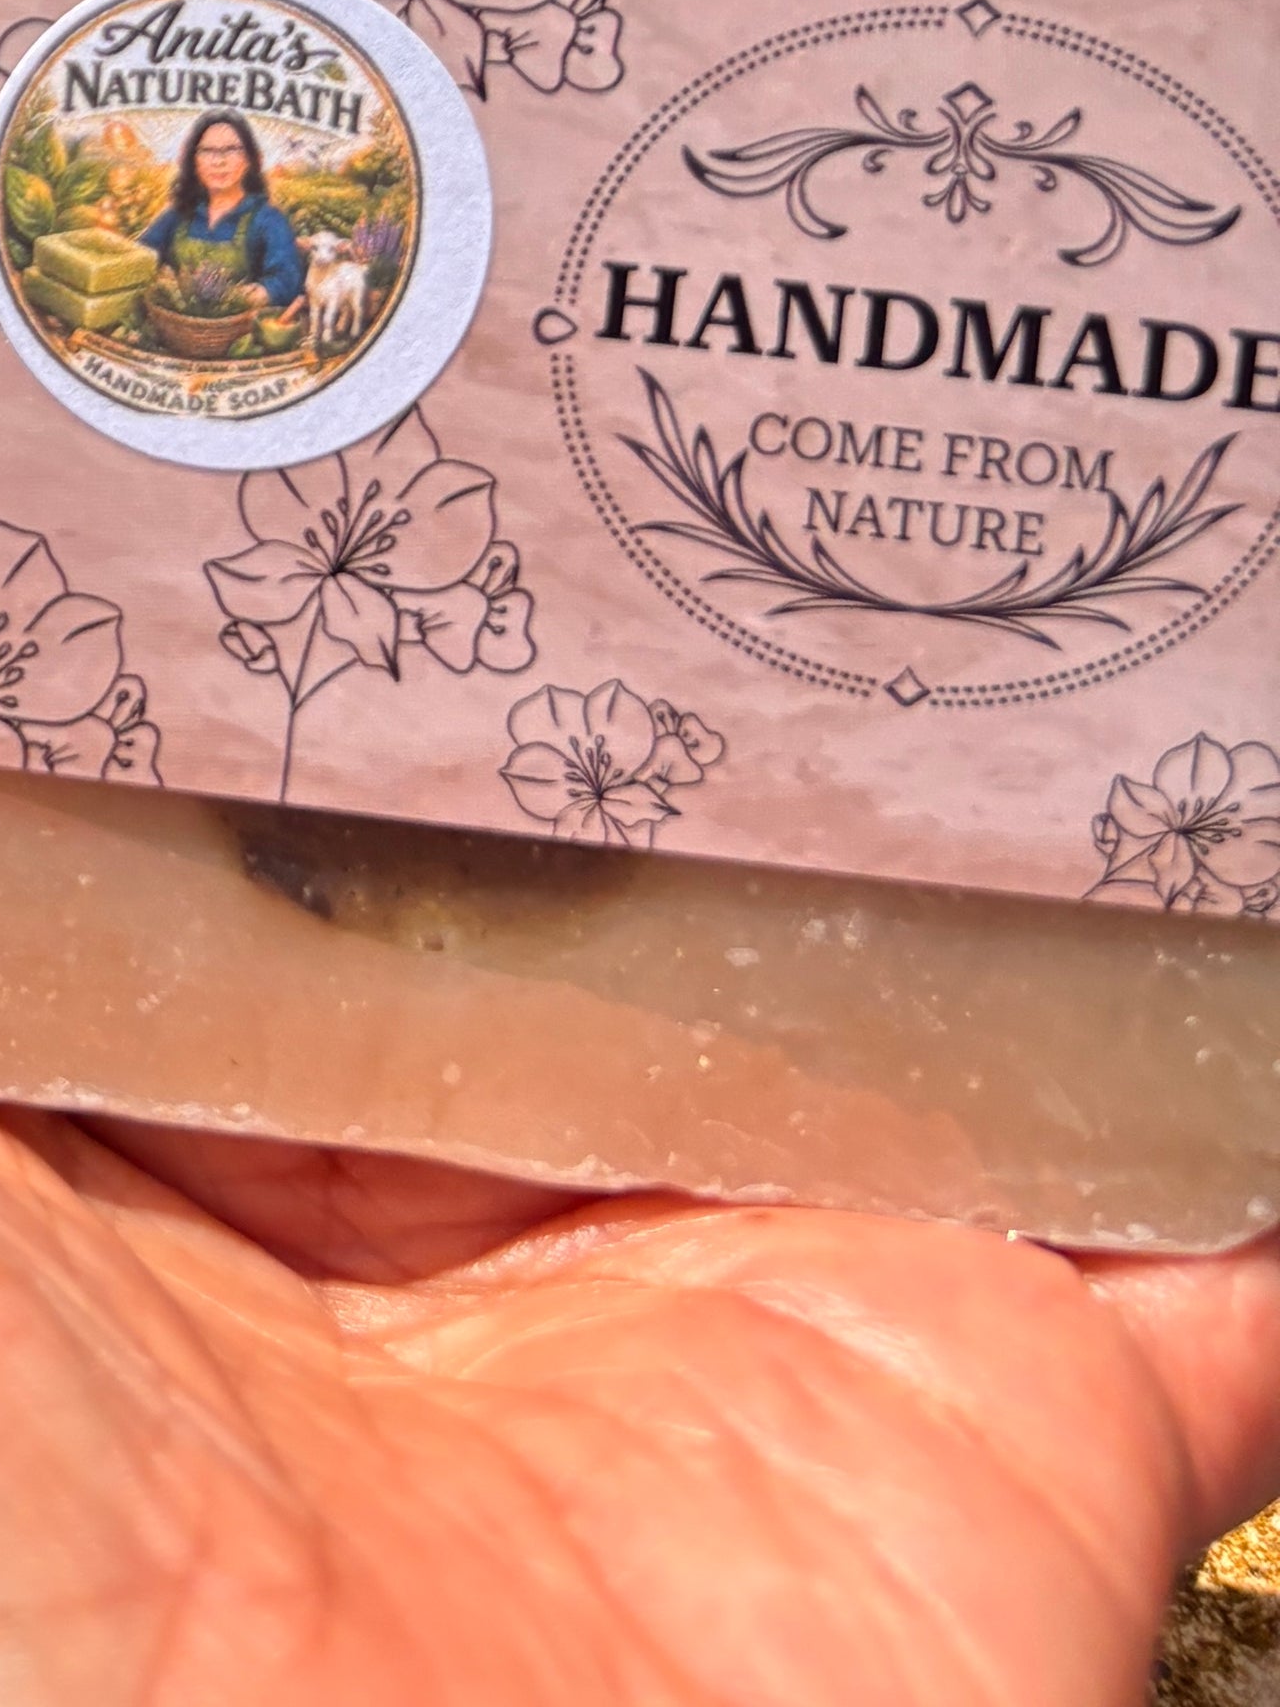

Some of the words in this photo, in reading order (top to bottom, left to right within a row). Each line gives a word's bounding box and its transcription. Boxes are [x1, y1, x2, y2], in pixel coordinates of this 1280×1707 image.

[594, 260, 1280, 413] HANDMADE
[83, 353, 218, 413] HANDMADE
[229, 377, 289, 411] SOAP
[748, 411, 926, 474] COME
[942, 431, 1115, 493] FROM
[802, 488, 1047, 556] NATURE
